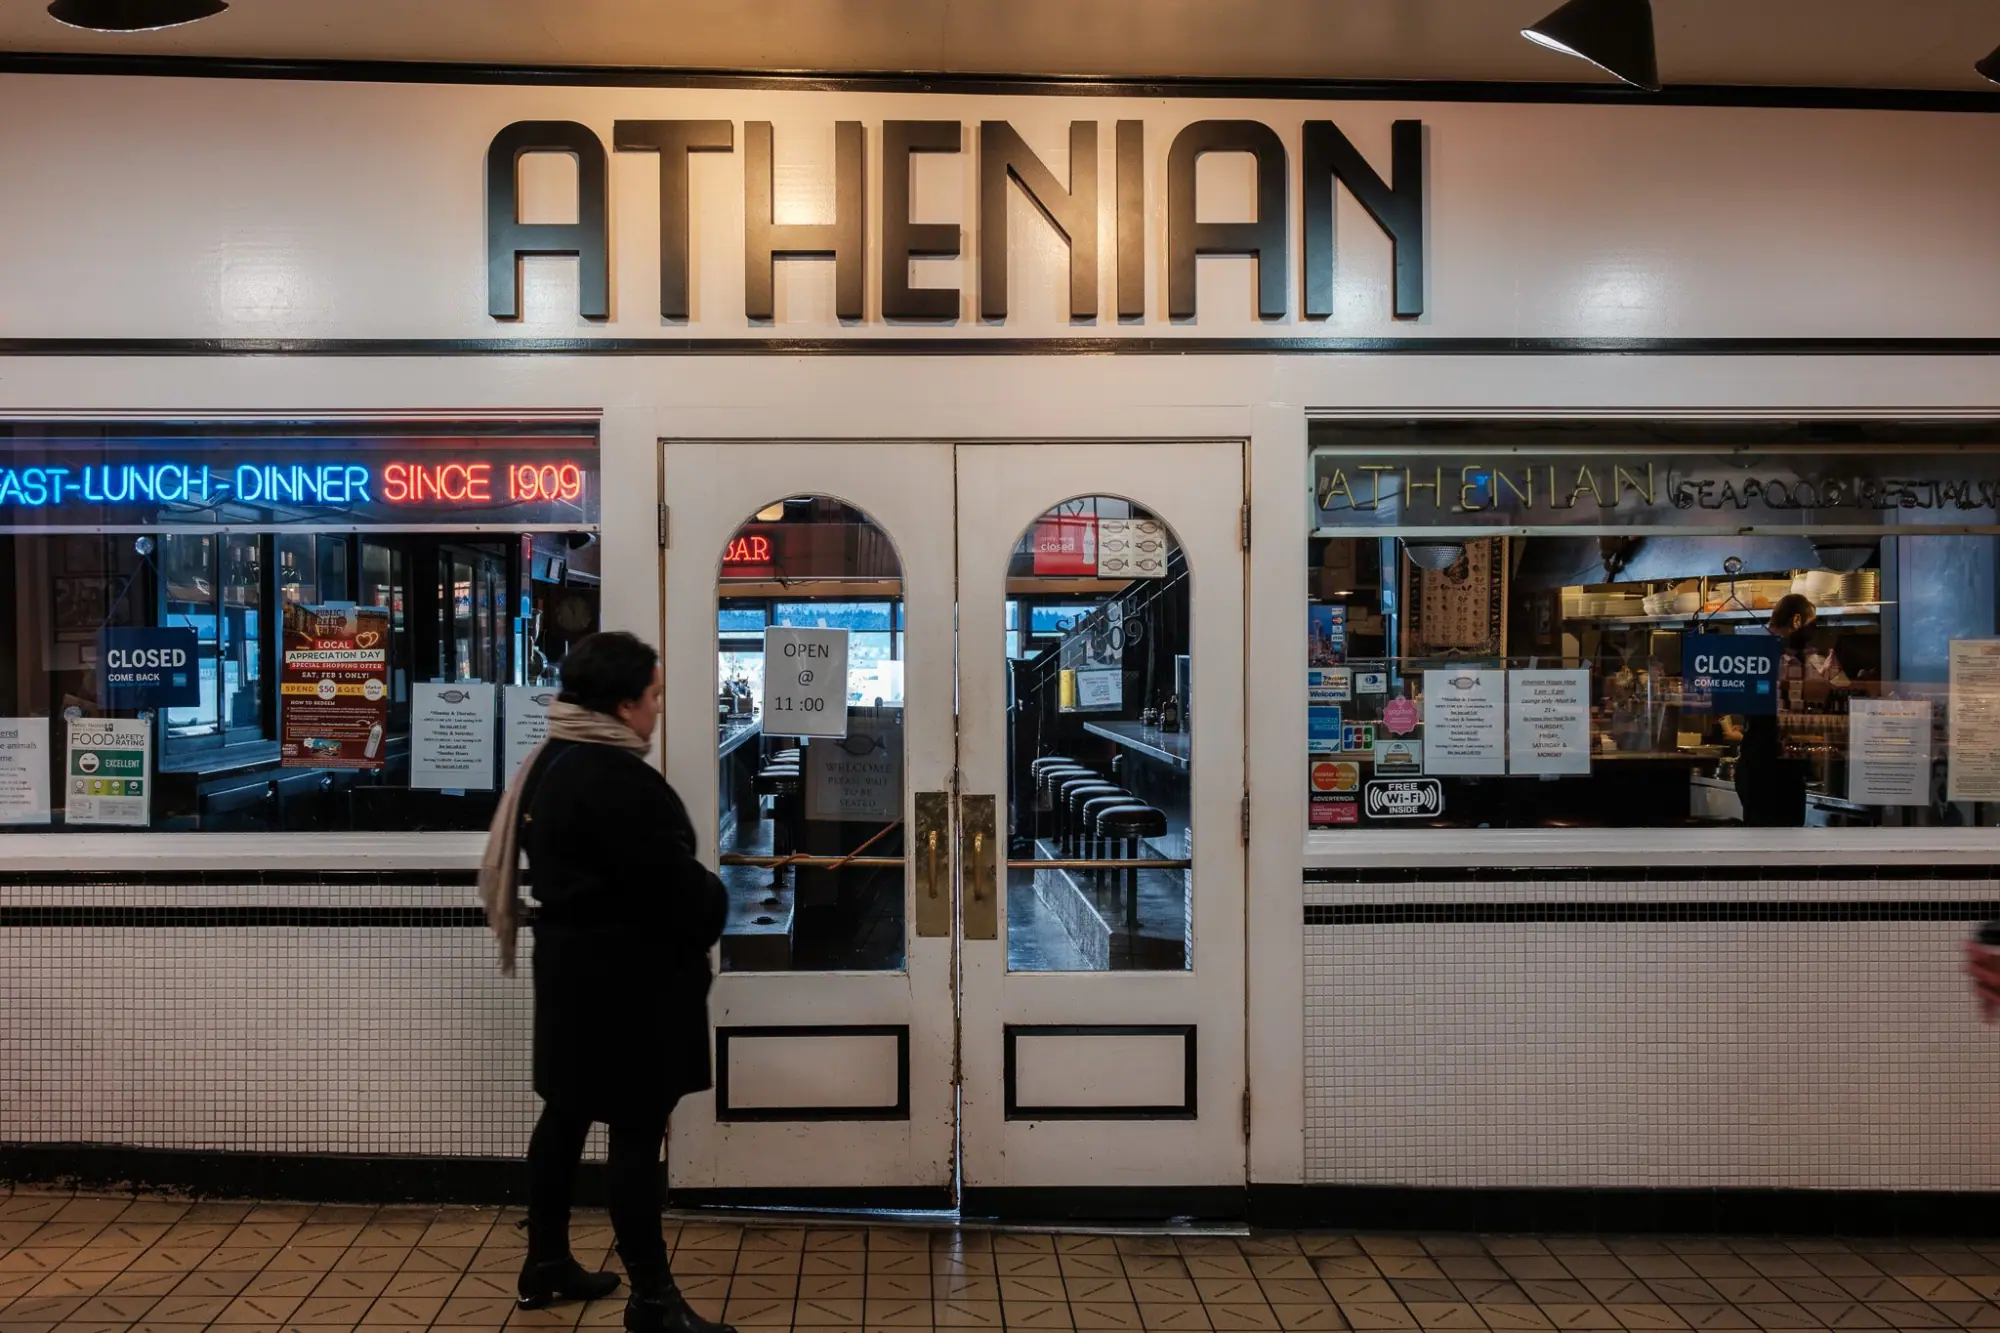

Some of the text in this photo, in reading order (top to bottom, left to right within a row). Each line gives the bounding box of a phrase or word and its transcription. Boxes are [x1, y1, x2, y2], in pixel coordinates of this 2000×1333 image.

[487, 119, 1424, 319] ATHENIAN
[384, 464, 490, 500] SINCE
[509, 464, 581, 500] 1909
[1321, 462, 1654, 510] ATHENIAN
[1041, 541, 1075, 551] closed
[318, 641, 350, 649] LOCAL
[784, 643, 829, 658] OPEN
[107, 649, 187, 668] CLOSED
[289, 651, 381, 660] APPRECIATION DAY
[1694, 654, 1771, 675] CLOSED
[108, 673, 161, 682] COME BACK
[797, 670, 814, 686] @
[1694, 679, 1745, 688] COME BACK
[319, 685, 335, 693] $50
[1309, 690, 1346, 698] Welcome
[71, 733, 115, 746] FOOD
[1344, 734, 1372, 743] JCB
[7, 742, 37, 750] animals
[105, 759, 140, 768] EXCELLENT
[825, 762, 893, 774] WELCOME
[1388, 782, 1418, 791] FREE
[1386, 793, 1421, 804] Wi-Fi
[1388, 806, 1419, 814] INSIDE
